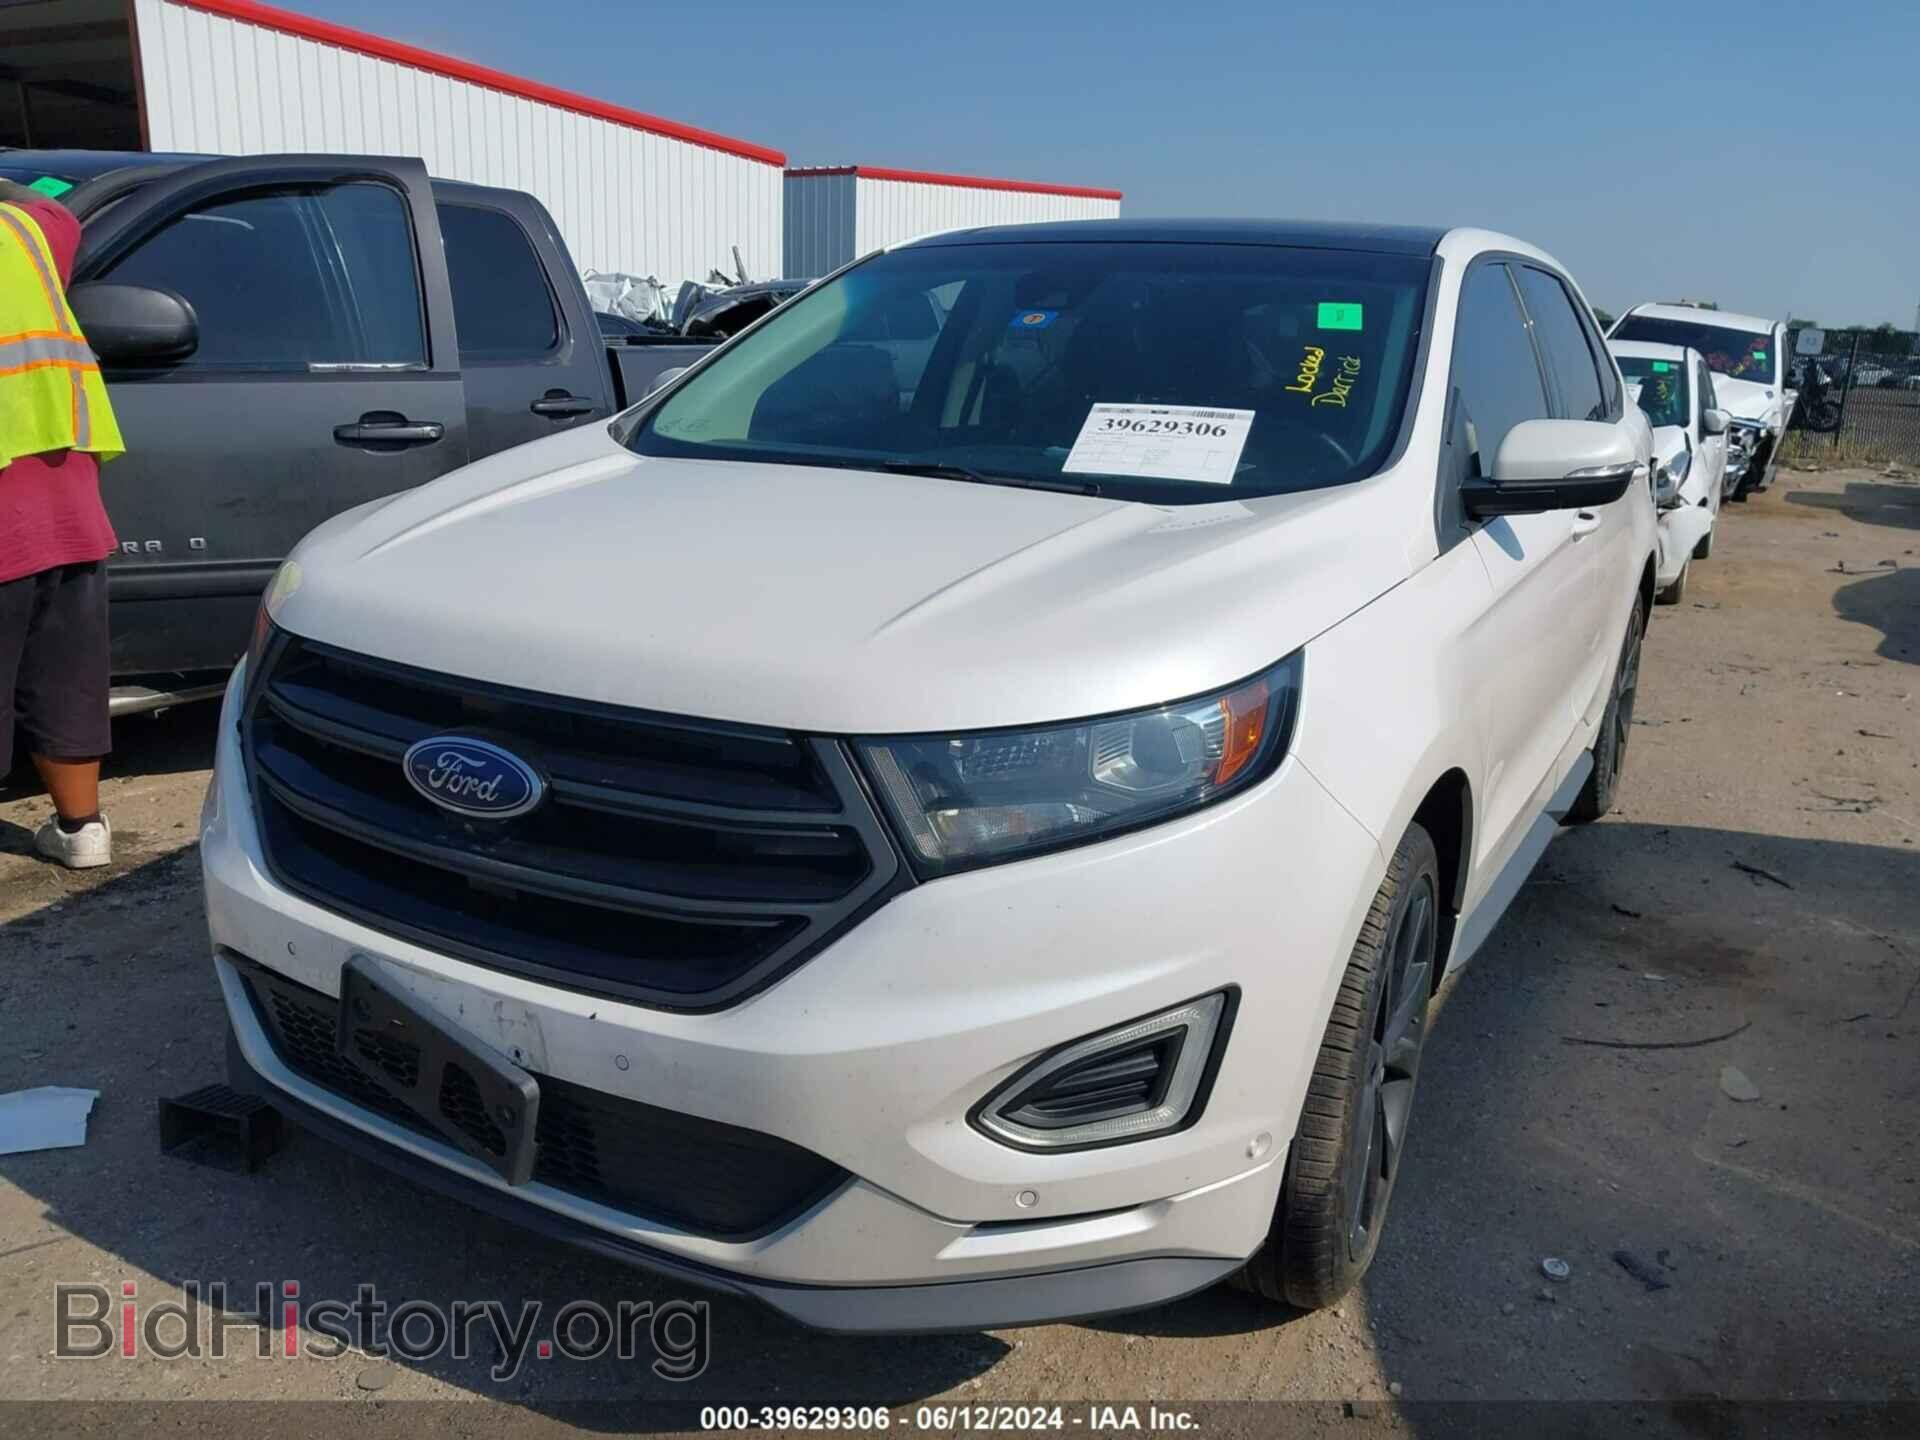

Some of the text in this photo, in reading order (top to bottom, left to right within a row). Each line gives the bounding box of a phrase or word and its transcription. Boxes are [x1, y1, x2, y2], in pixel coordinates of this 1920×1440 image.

[1312, 355, 1361, 407] Derrick
[1098, 418, 1228, 438] 39629306
[428, 751, 503, 801] Ford
